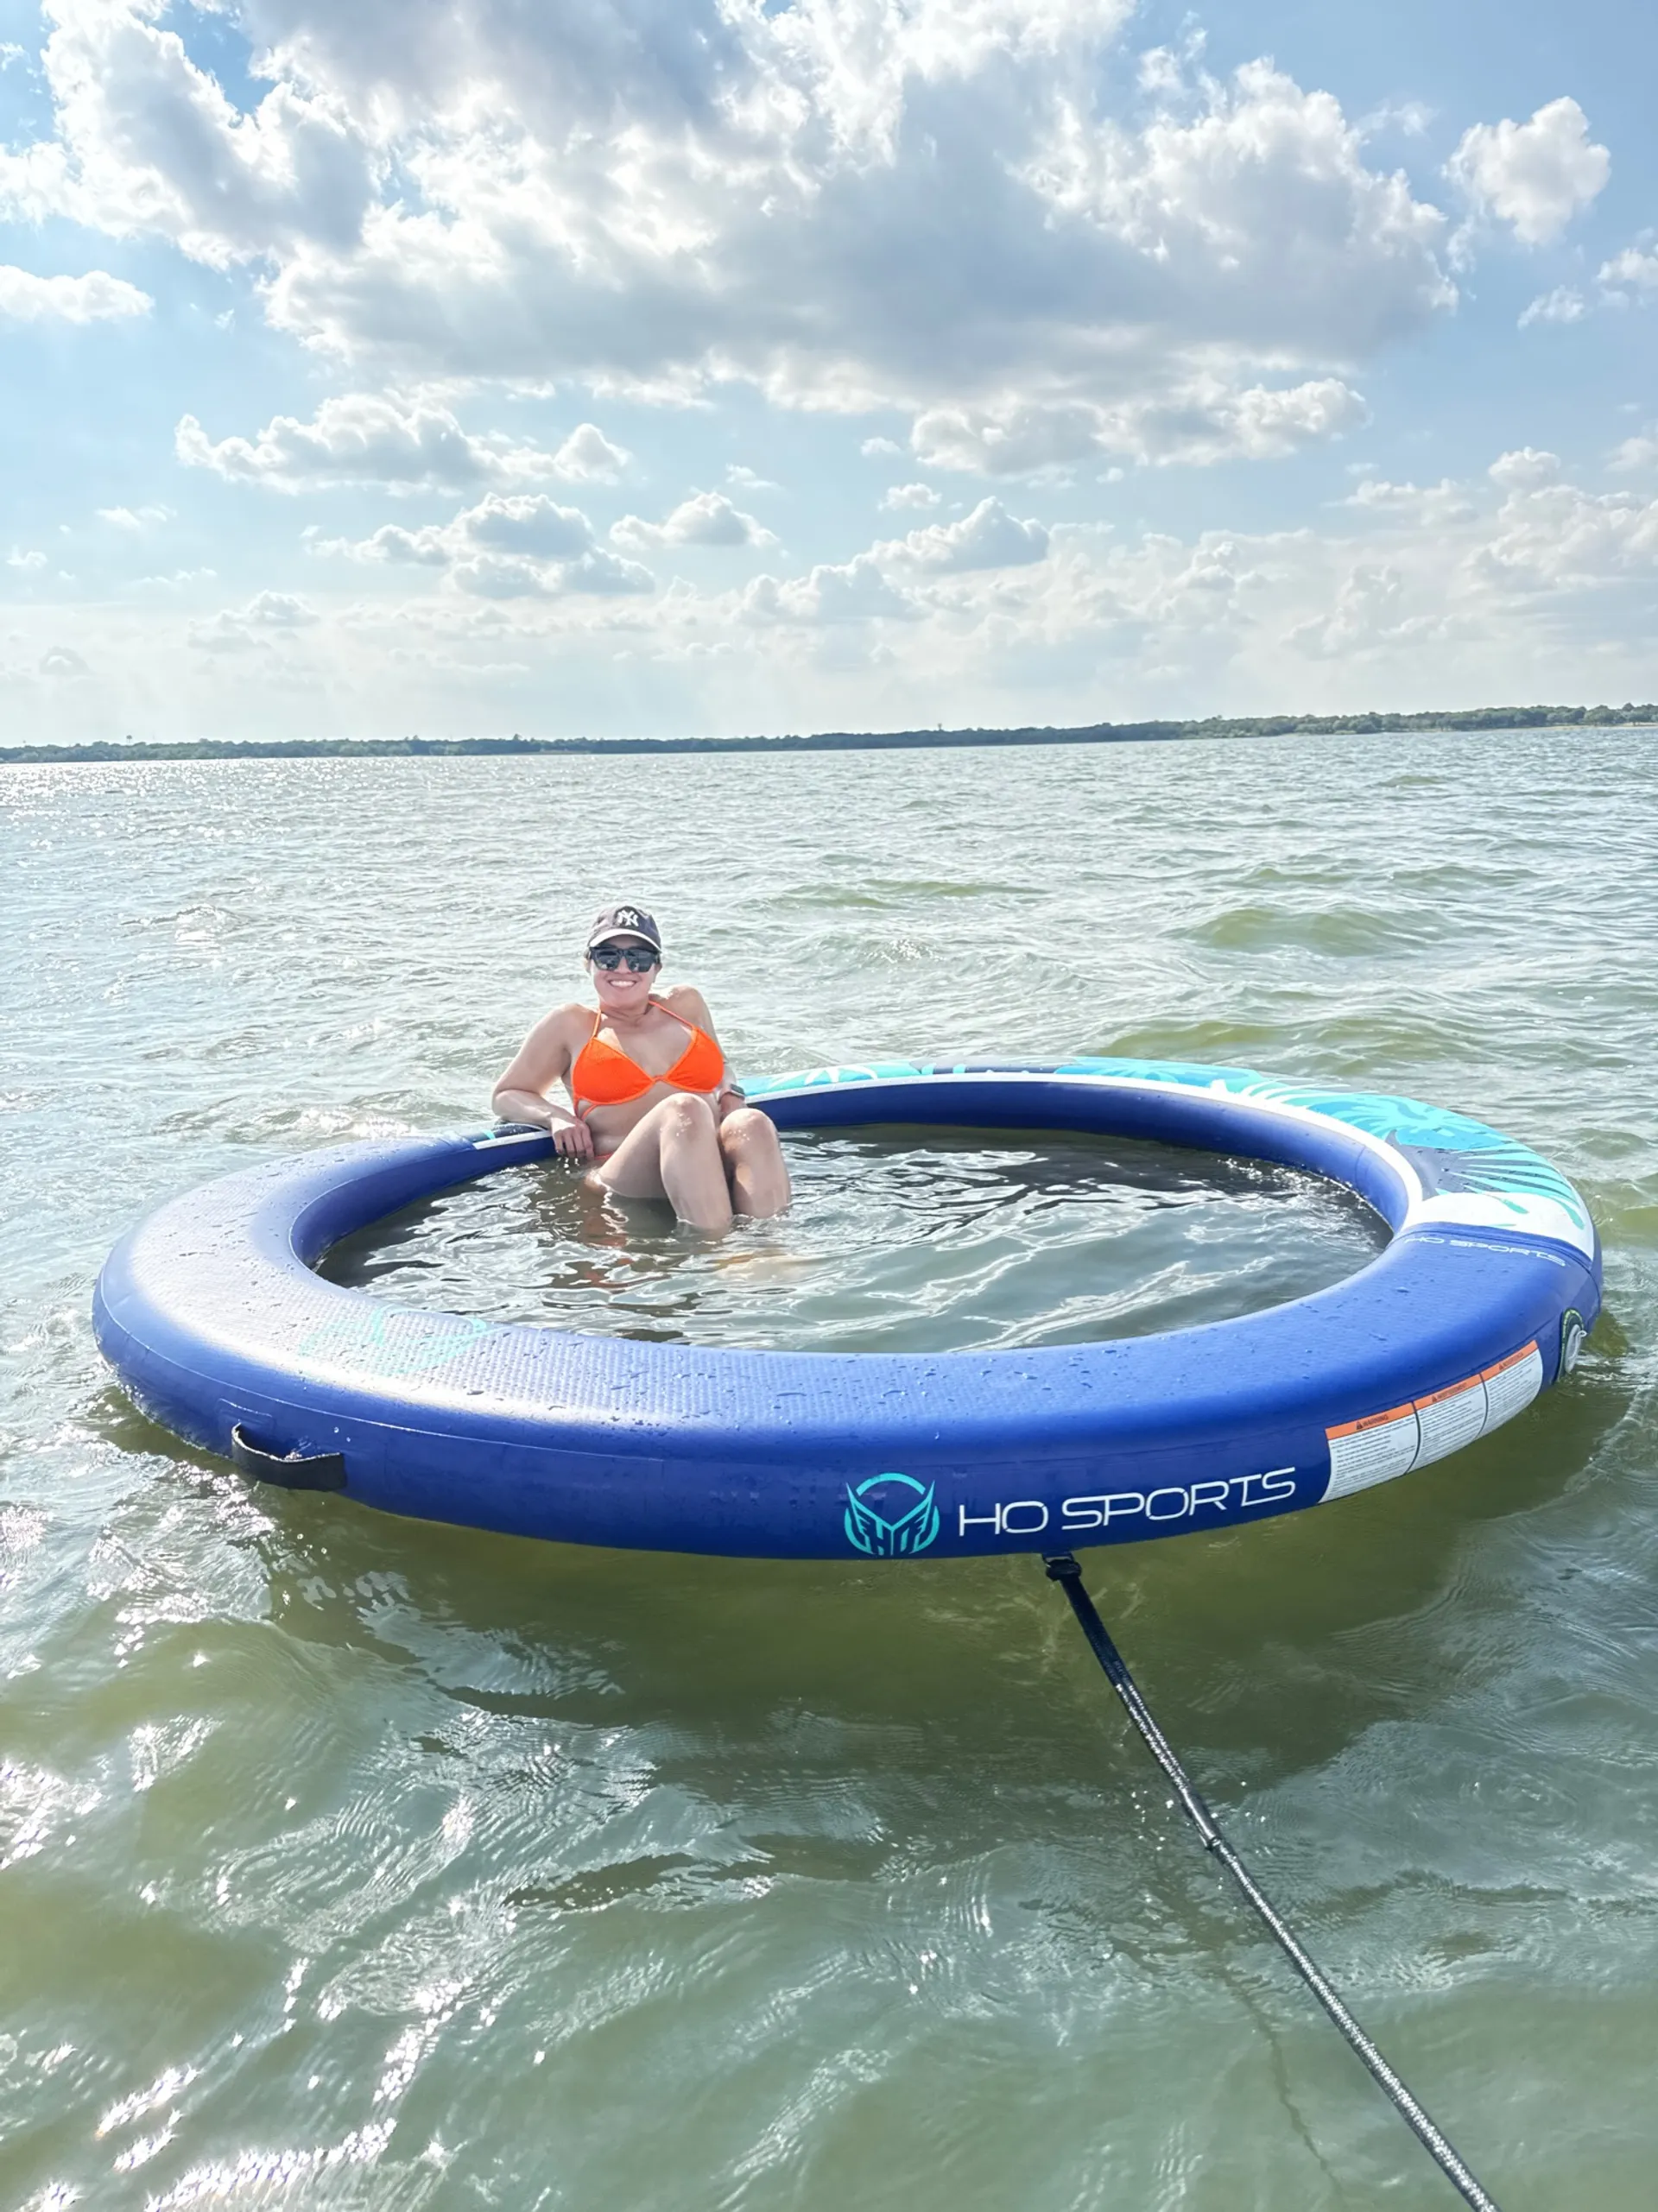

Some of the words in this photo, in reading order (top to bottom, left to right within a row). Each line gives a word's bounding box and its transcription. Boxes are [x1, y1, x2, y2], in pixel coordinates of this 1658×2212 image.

[617, 910, 639, 926] NY
[1450, 1239, 1566, 1267] SPORTS
[959, 1501, 1048, 1536] HO
[1061, 1467, 1295, 1530] SPORTS
